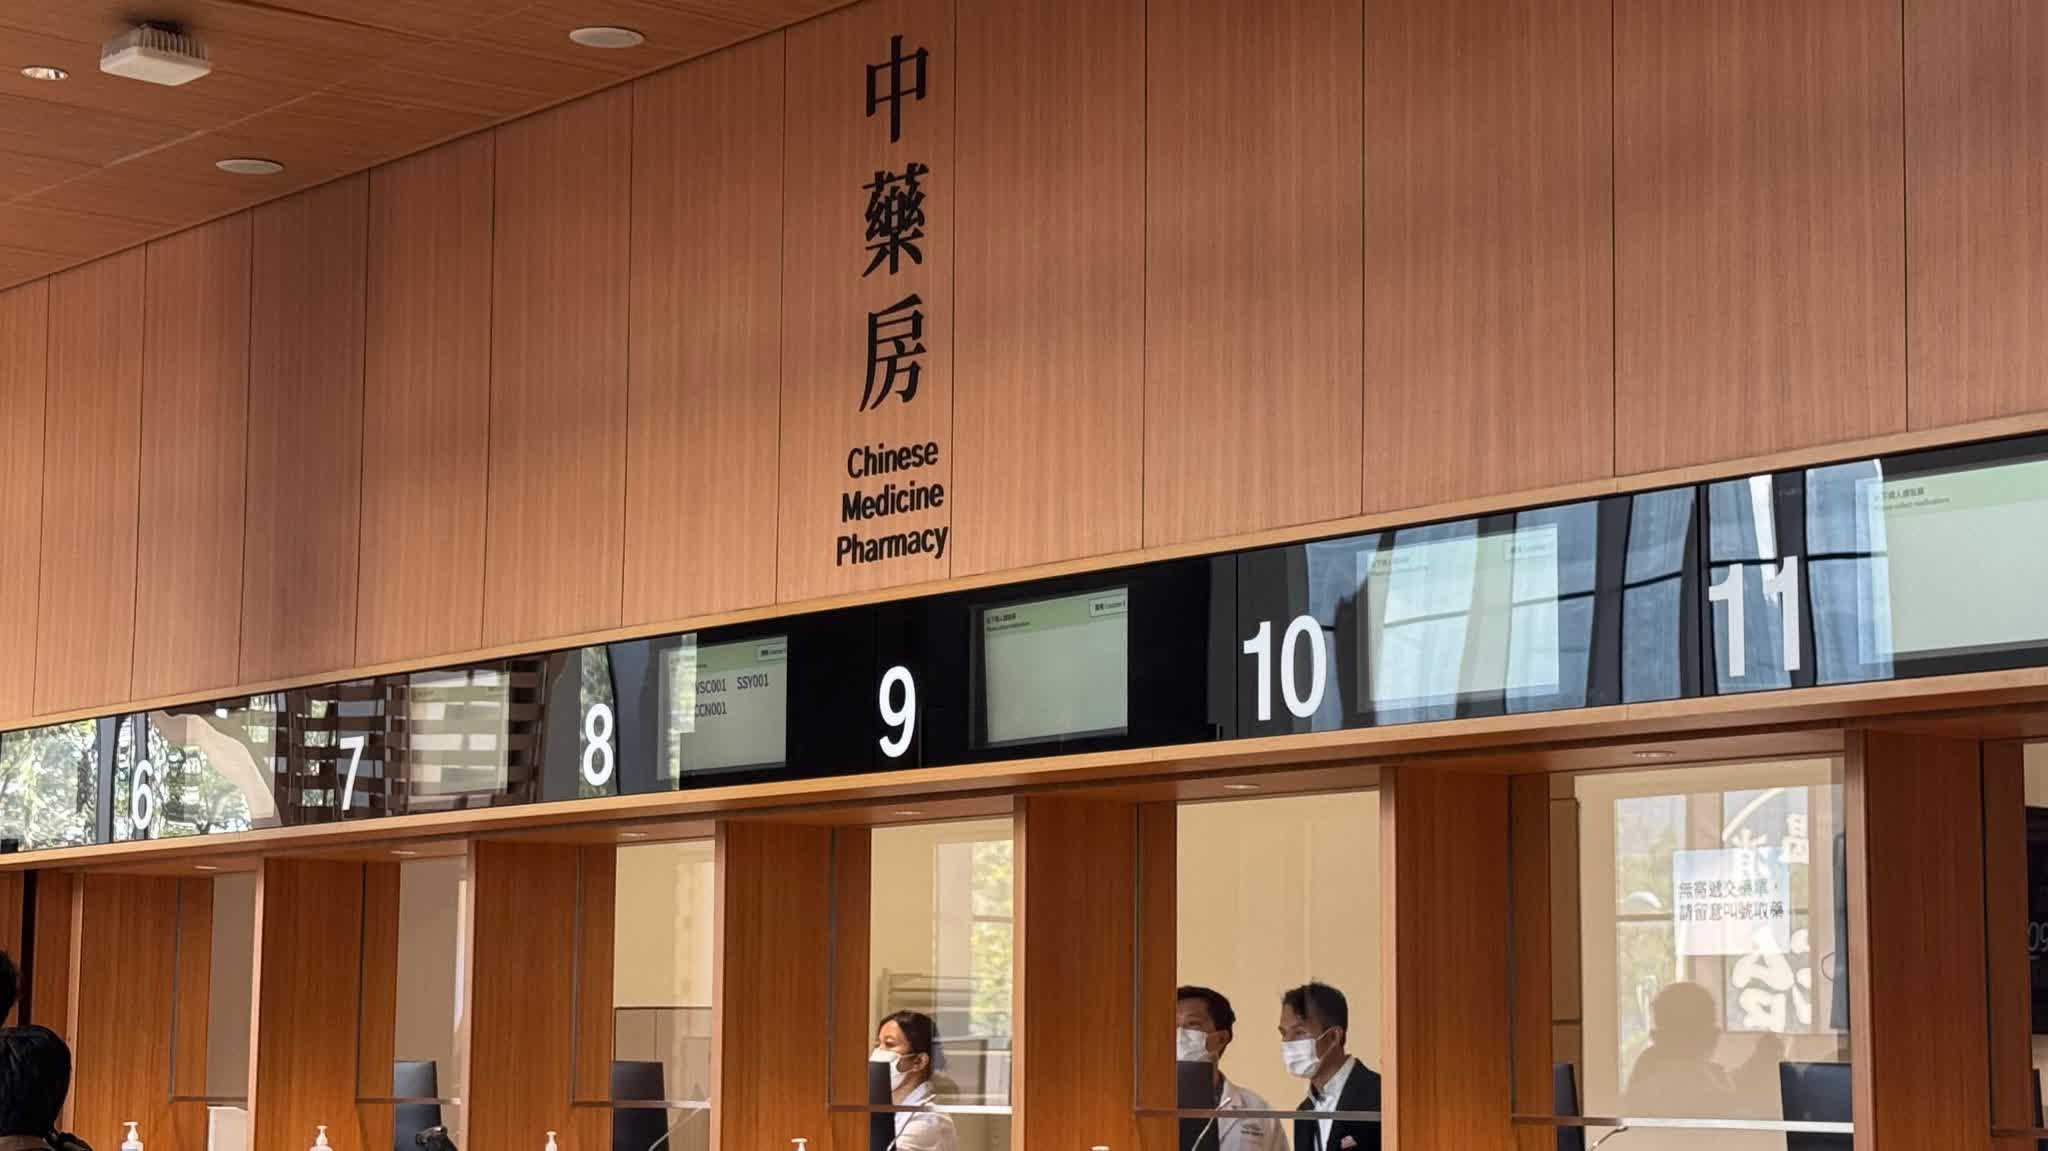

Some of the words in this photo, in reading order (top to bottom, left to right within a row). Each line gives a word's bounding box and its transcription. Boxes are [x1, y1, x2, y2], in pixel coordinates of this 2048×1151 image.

[859, 34, 929, 413] 中藥房
[847, 441, 939, 479] Chinese
[842, 480, 944, 523] Medicine
[836, 526, 949, 567] Pharmacy
[1708, 555, 1801, 678] 11
[1243, 615, 1327, 721] 10
[583, 703, 614, 786] 8
[879, 665, 917, 758] 9
[132, 759, 154, 830] 6
[339, 735, 365, 811] 7
